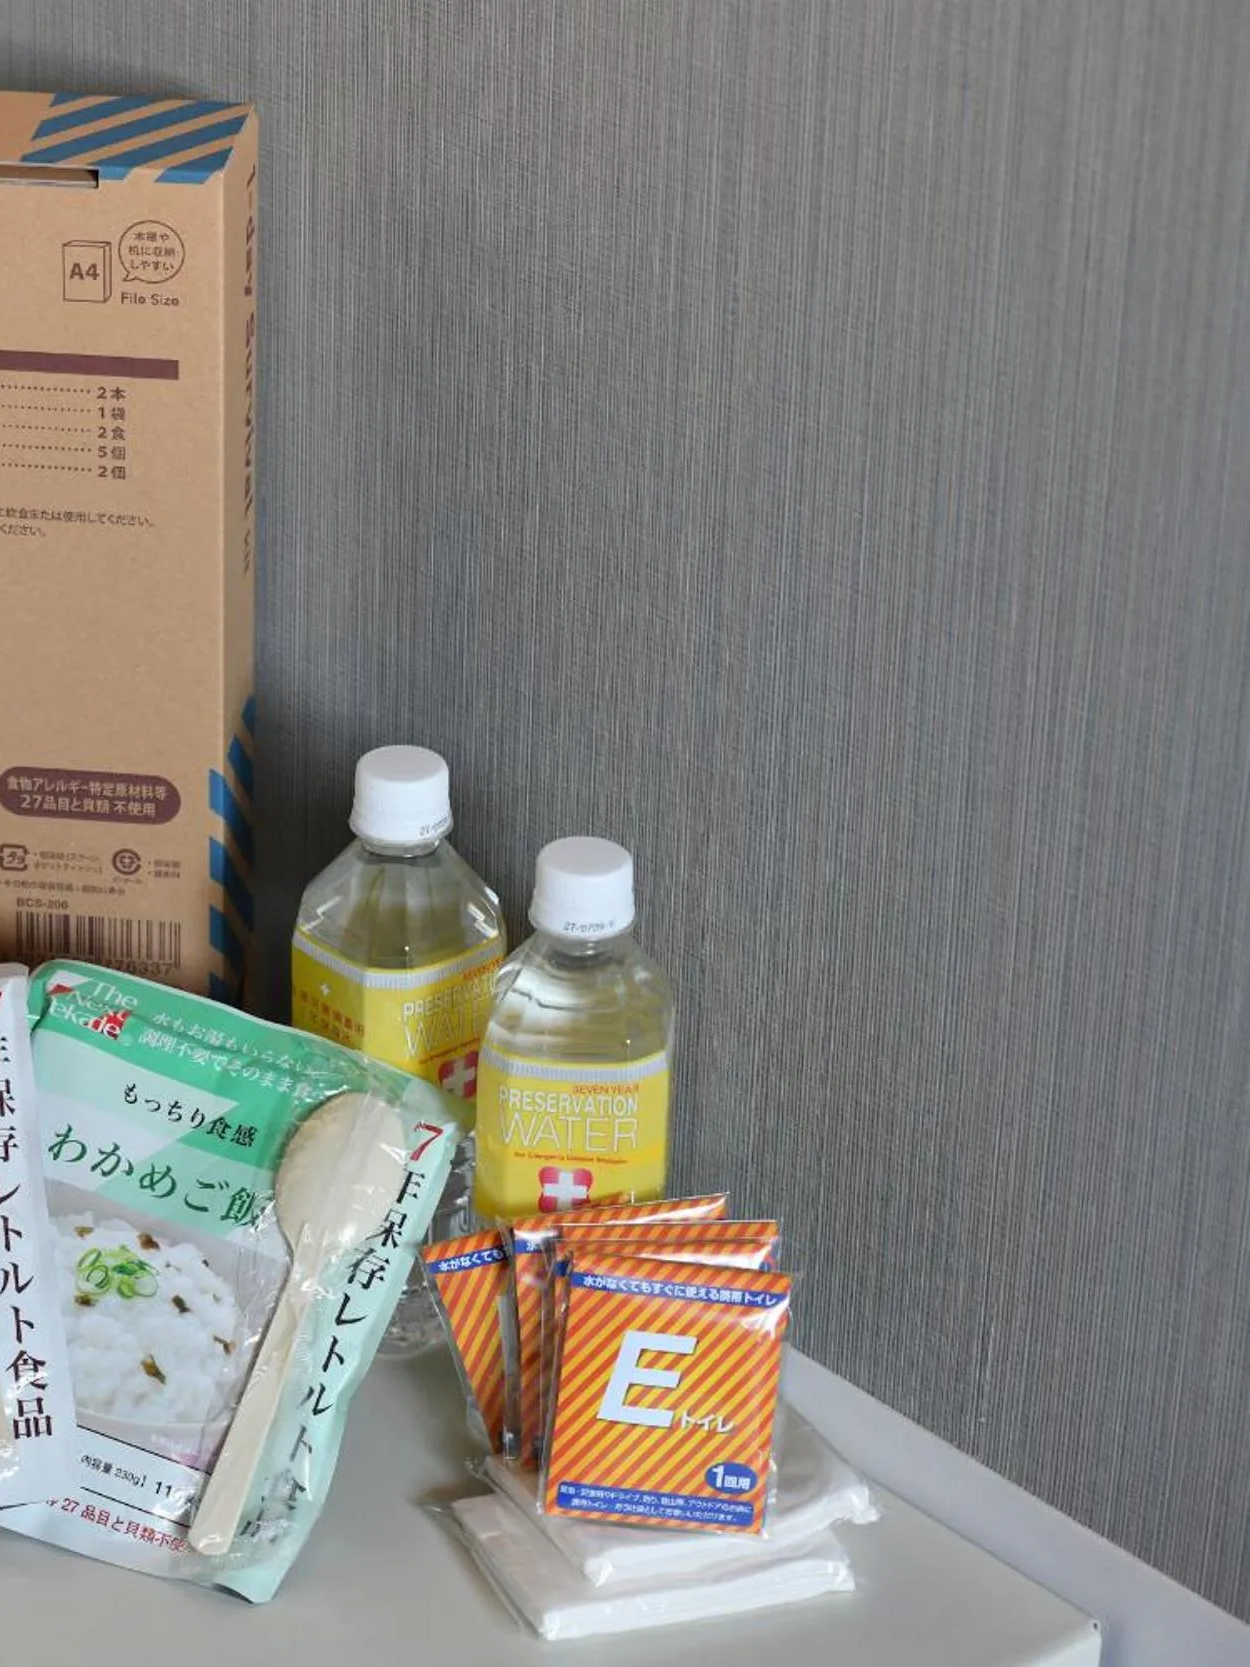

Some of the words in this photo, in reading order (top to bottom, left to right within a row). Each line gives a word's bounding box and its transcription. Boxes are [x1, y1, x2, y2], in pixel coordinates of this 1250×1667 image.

[69, 262, 100, 281] A4
[120, 291, 146, 305] File
[150, 293, 180, 306] Size
[96, 386, 127, 401] 2本
[97, 426, 126, 441] 2食
[97, 446, 127, 461] 5個
[97, 465, 127, 481] 2個
[7, 776, 167, 800] 食物アレルギー特定原材料等
[90, 980, 138, 1009] The
[499, 1085, 639, 1117] PRESERVATION
[124, 1083, 258, 1148] もっちり食感
[501, 1111, 638, 1153] WATER
[48, 1123, 266, 1227] わかめご飯
[583, 1274, 778, 1308] 水がなくてもすぐに使える携帯トイレ
[597, 1329, 698, 1429] E
[681, 1410, 735, 1434] トイレ
[713, 1465, 751, 1491] 1回用
[60, 1497, 80, 1514] 27
